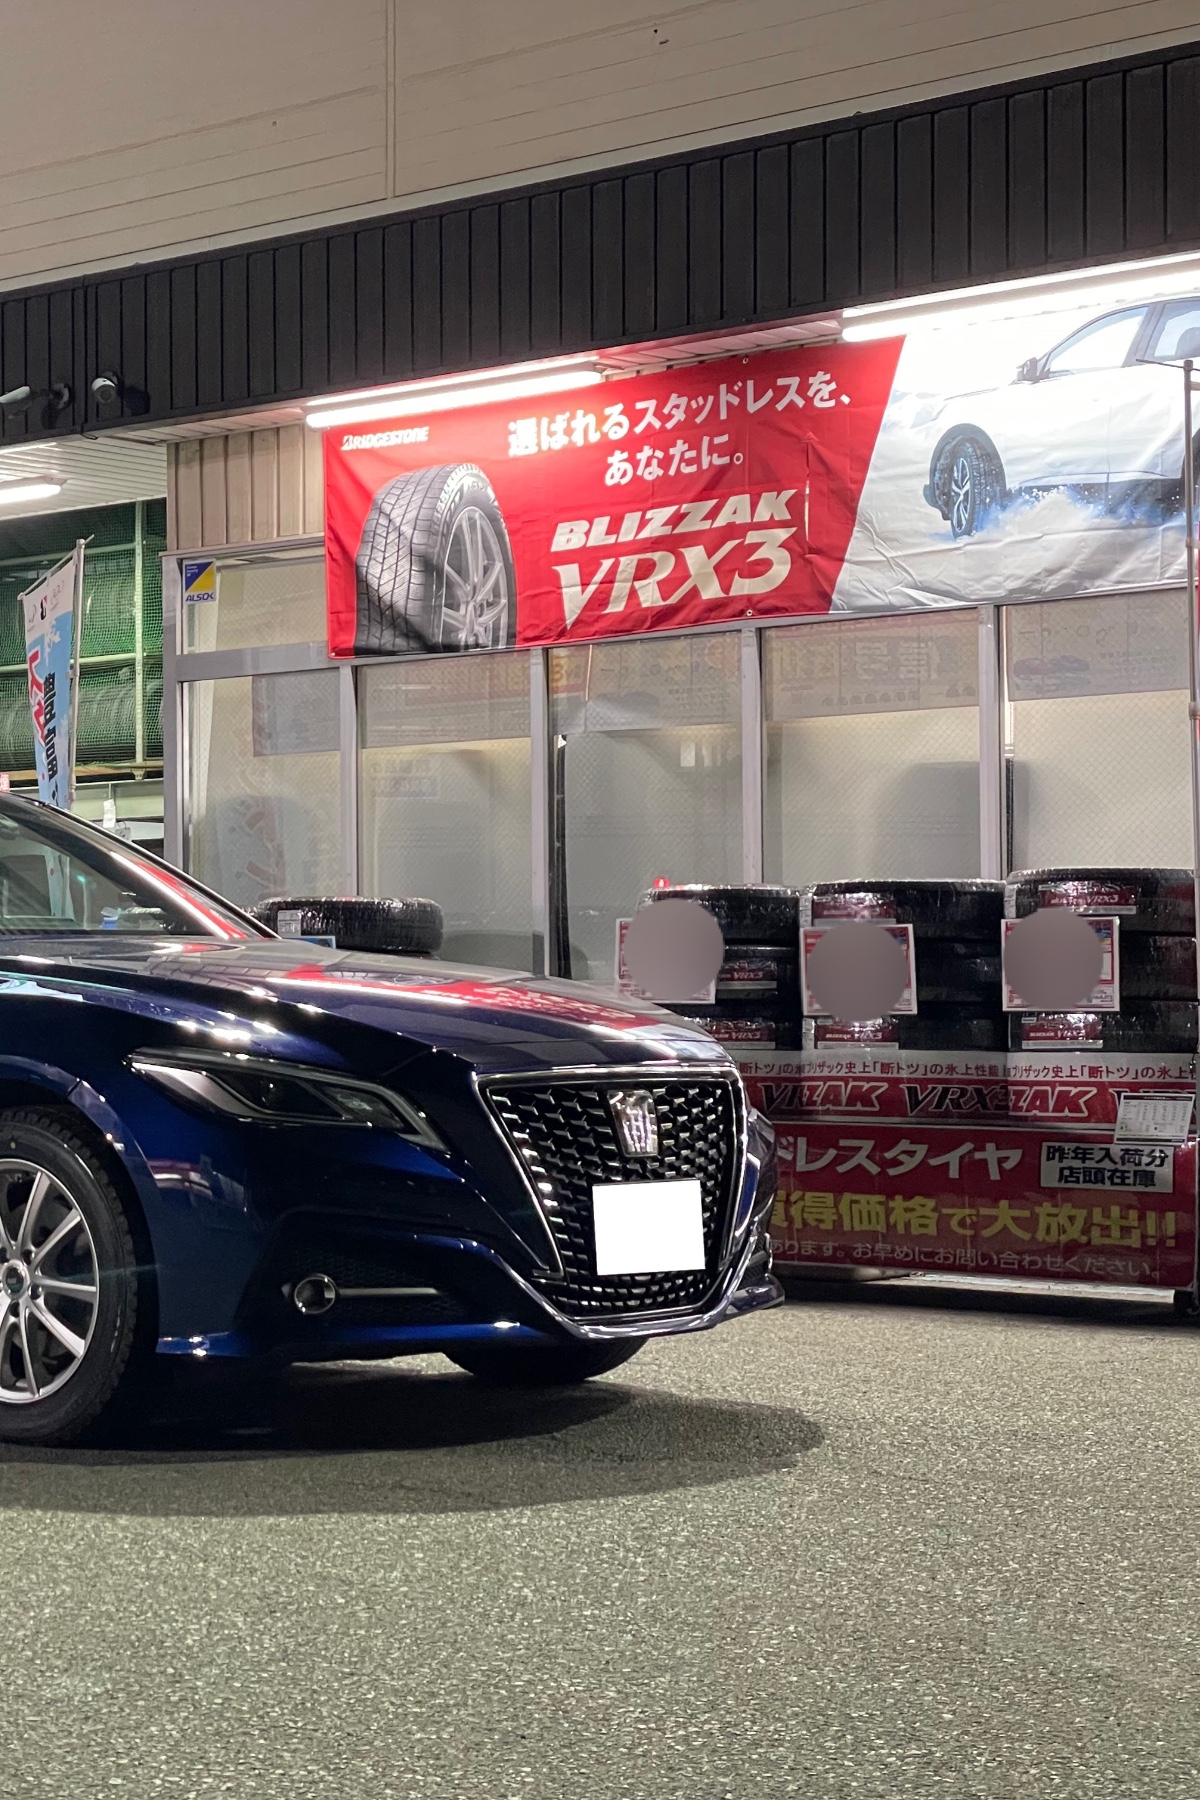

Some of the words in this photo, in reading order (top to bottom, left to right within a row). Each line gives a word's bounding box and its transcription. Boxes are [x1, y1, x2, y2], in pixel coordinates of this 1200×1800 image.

[507, 371, 851, 457] 選ばれるスタッドレスを、
[341, 426, 430, 450] BRIDGESTONE
[604, 434, 744, 487] あなたに。
[550, 488, 798, 552] BLIZZAK
[185, 592, 215, 602] ALSOK
[551, 527, 798, 631] VRX3
[1045, 1144, 1170, 1168] 昨年入荷分
[1057, 1165, 1157, 1188] 店頭在庫
